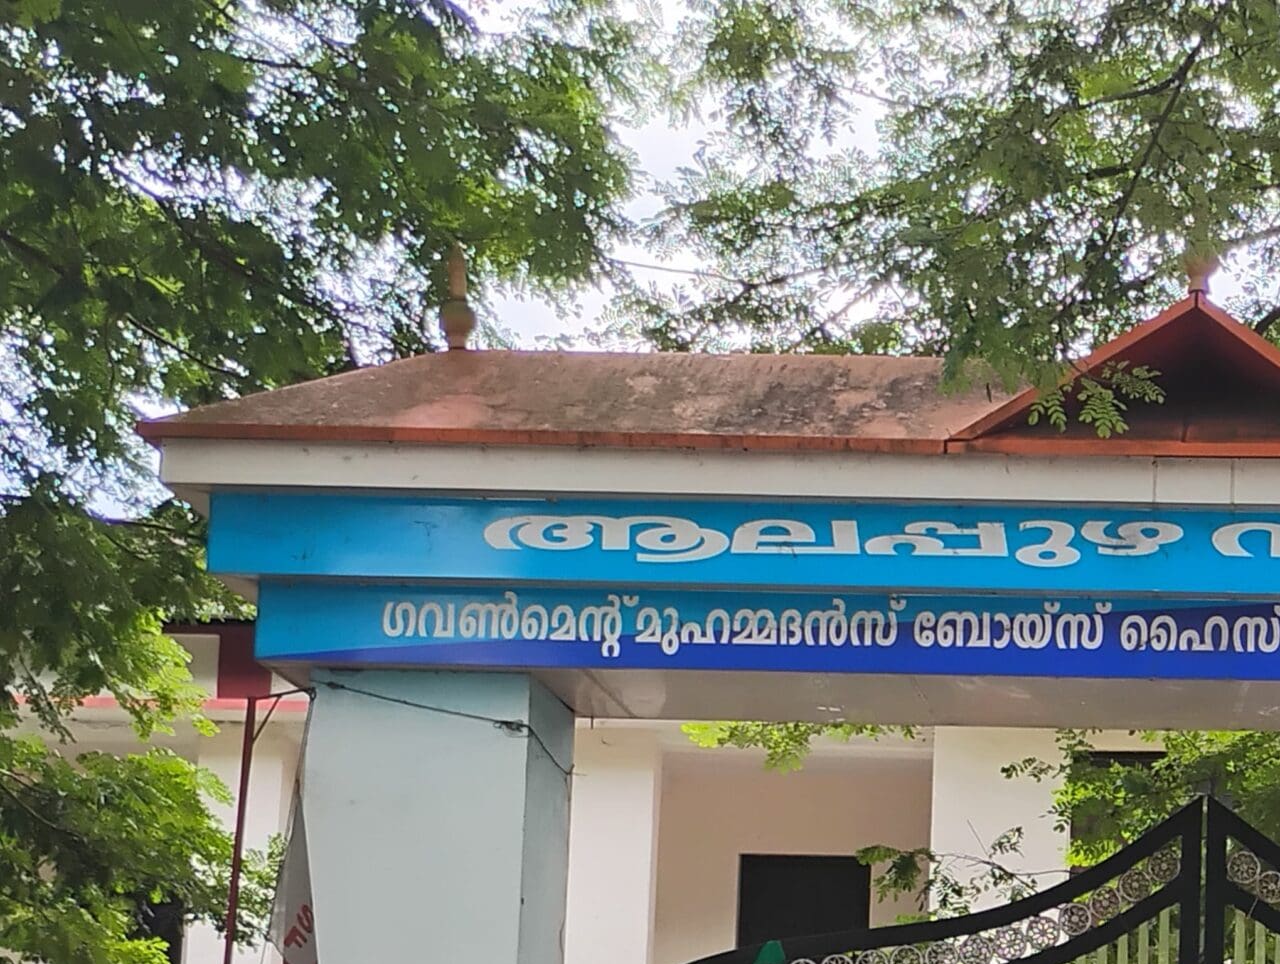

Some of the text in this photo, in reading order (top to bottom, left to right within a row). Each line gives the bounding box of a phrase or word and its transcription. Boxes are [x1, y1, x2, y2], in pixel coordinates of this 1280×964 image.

[483, 514, 1184, 567] ആലപ്പുഴ
[634, 600, 906, 656] മുഹമ്മദൻസ്
[913, 602, 1113, 651] ബോയ്സ്
